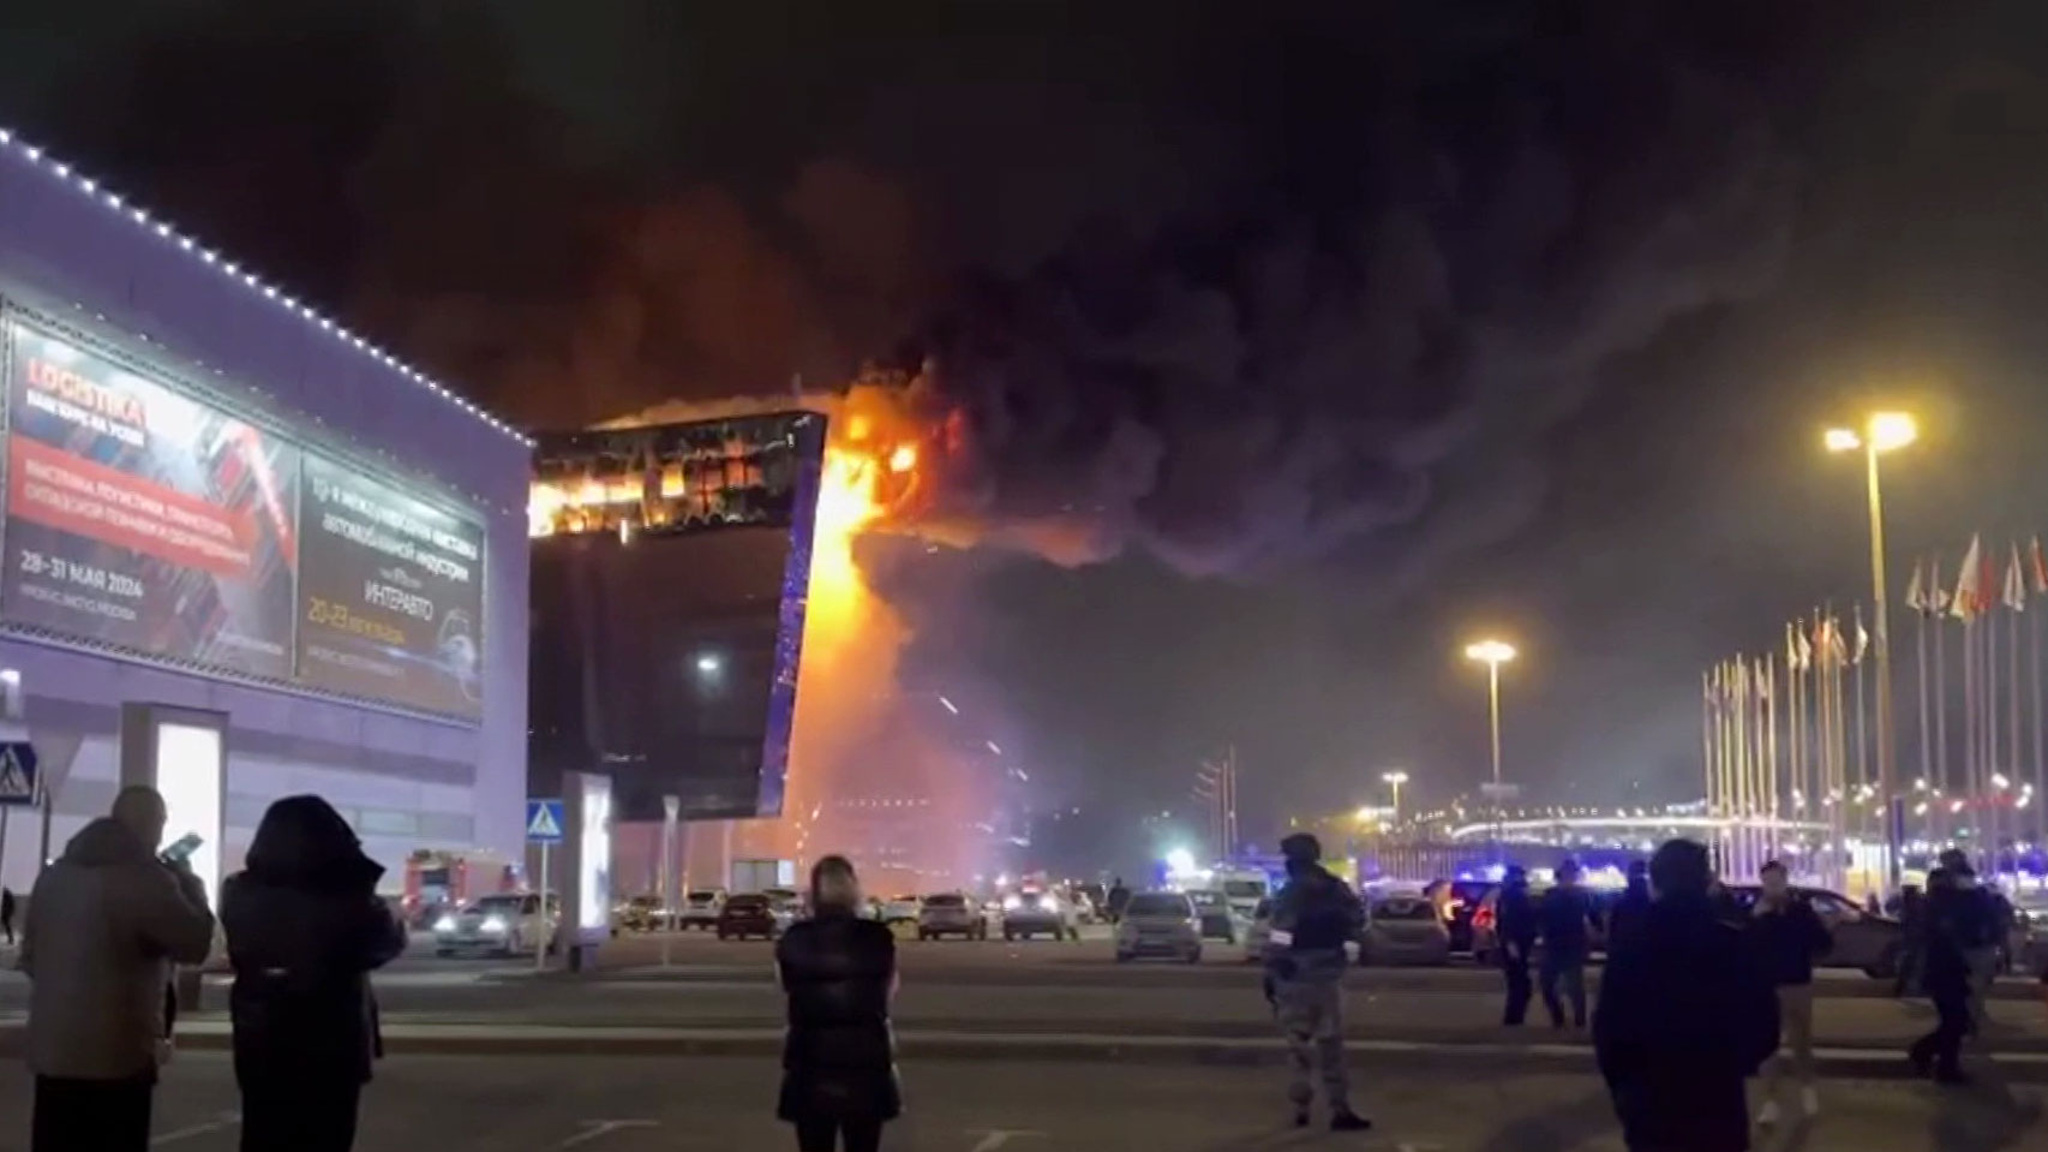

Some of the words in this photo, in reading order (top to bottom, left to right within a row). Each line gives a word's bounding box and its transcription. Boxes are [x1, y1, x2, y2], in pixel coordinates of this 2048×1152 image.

[28, 358, 146, 428] LOGISTIKA
[21, 550, 66, 579] 28-31
[70, 563, 106, 590] МАЯ
[108, 572, 143, 599] 2024
[365, 579, 433, 621] ИНТЕРАВТО
